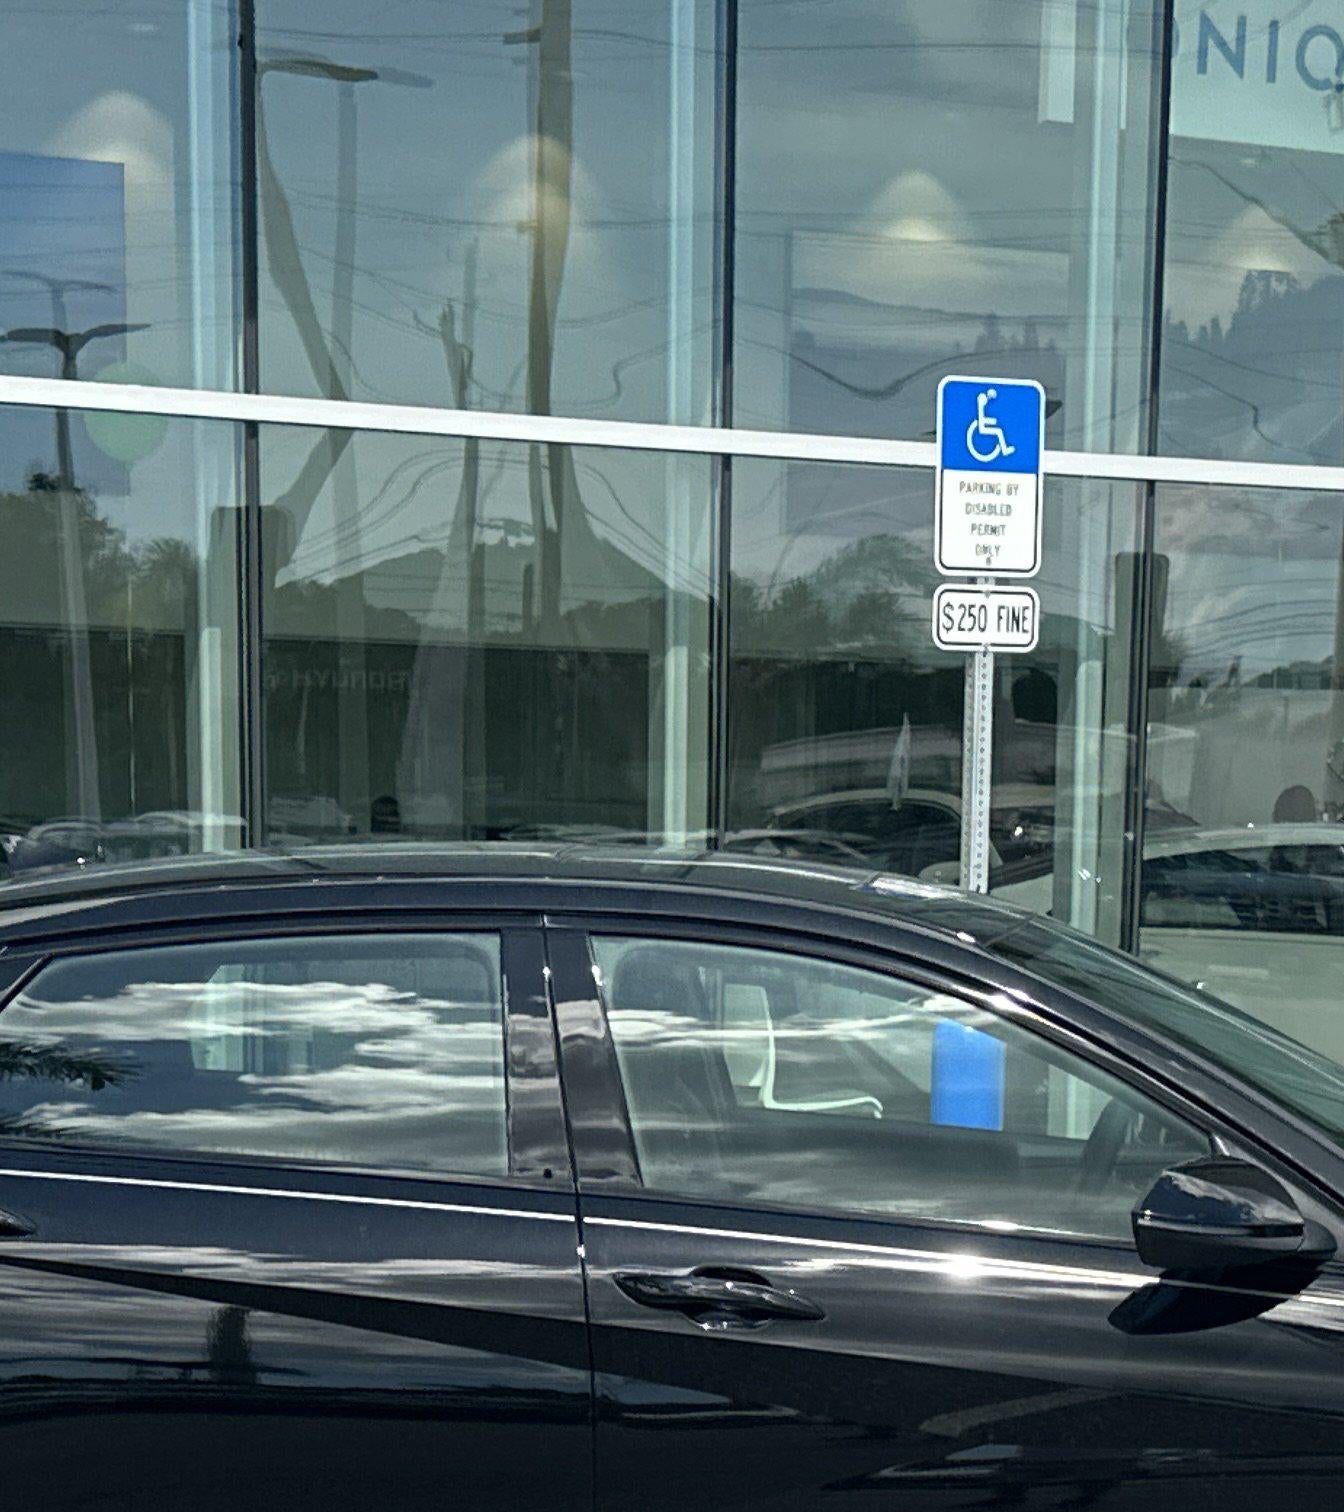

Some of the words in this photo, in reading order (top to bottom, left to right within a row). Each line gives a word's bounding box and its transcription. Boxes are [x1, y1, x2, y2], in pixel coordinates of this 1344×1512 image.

[959, 480, 1001, 496] PARKING
[965, 502, 1012, 516] DISABLED
[970, 523, 1006, 536] PERMIT
[942, 601, 988, 634] $250
[997, 605, 1030, 634] FINE
